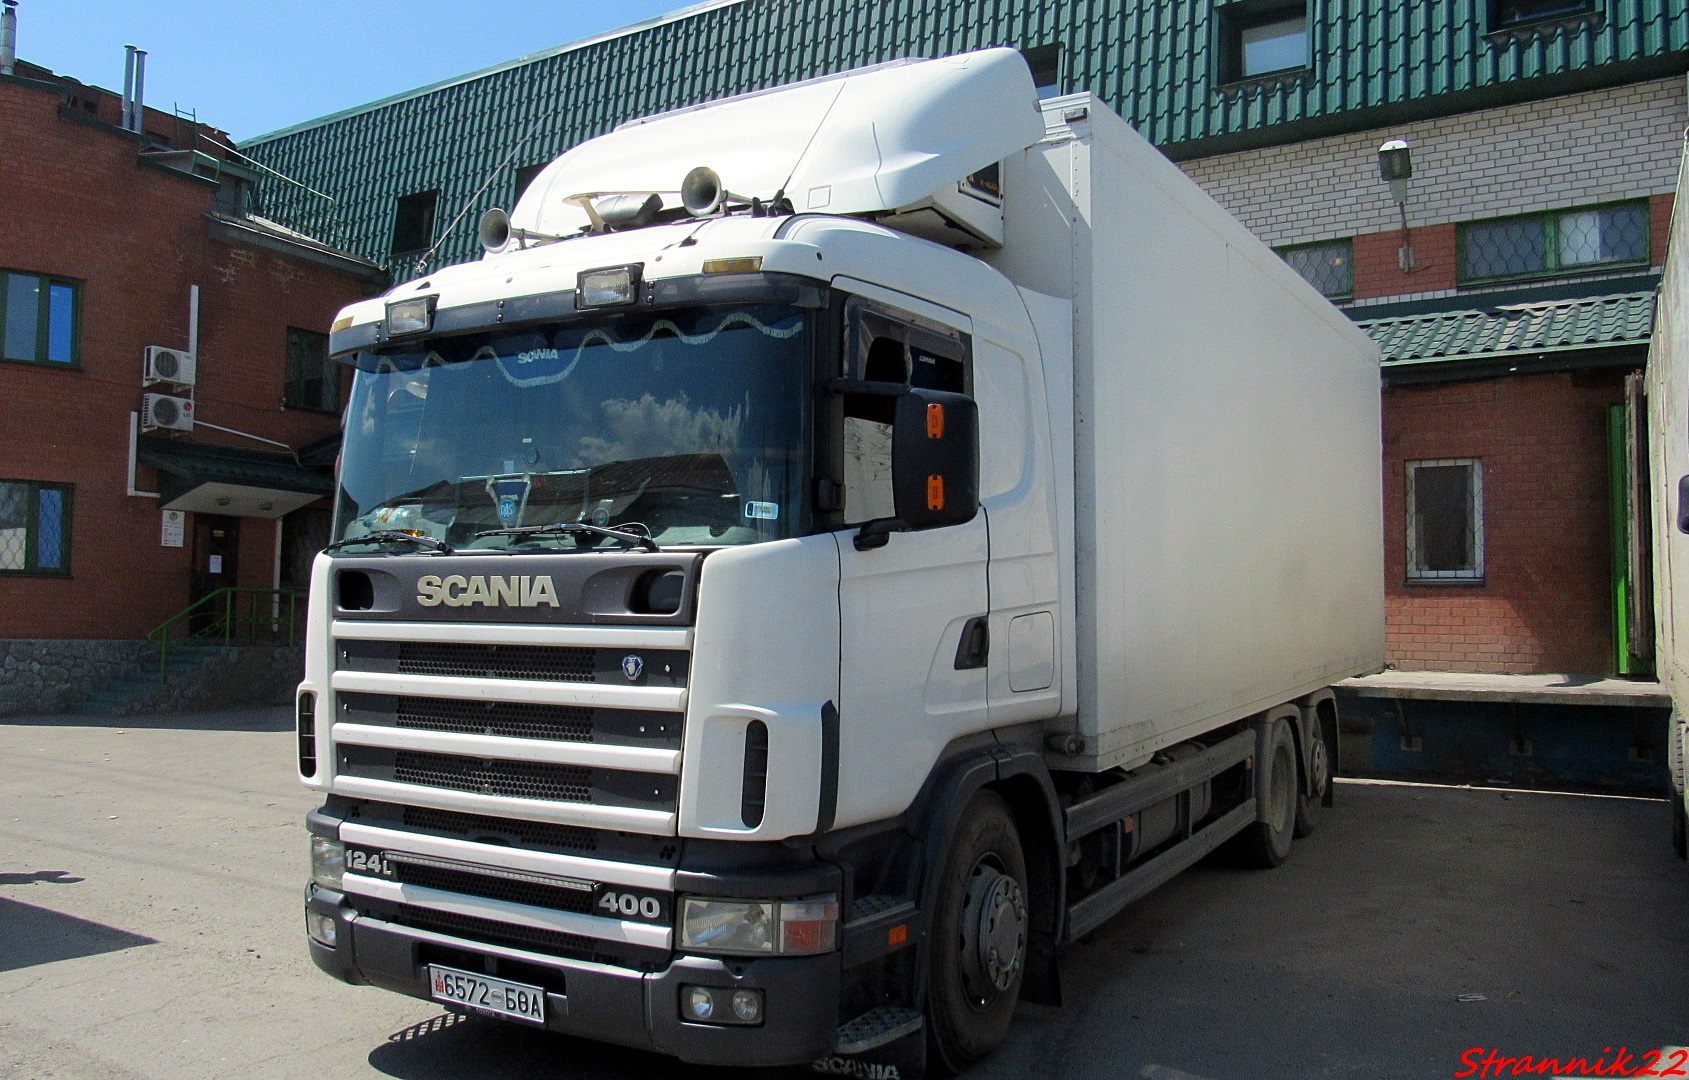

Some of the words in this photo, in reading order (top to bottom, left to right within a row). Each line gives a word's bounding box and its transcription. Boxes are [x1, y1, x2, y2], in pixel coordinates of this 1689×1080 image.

[417, 575, 560, 607] SCANIA
[599, 892, 660, 918] 400
[444, 974, 490, 1005] 6572
